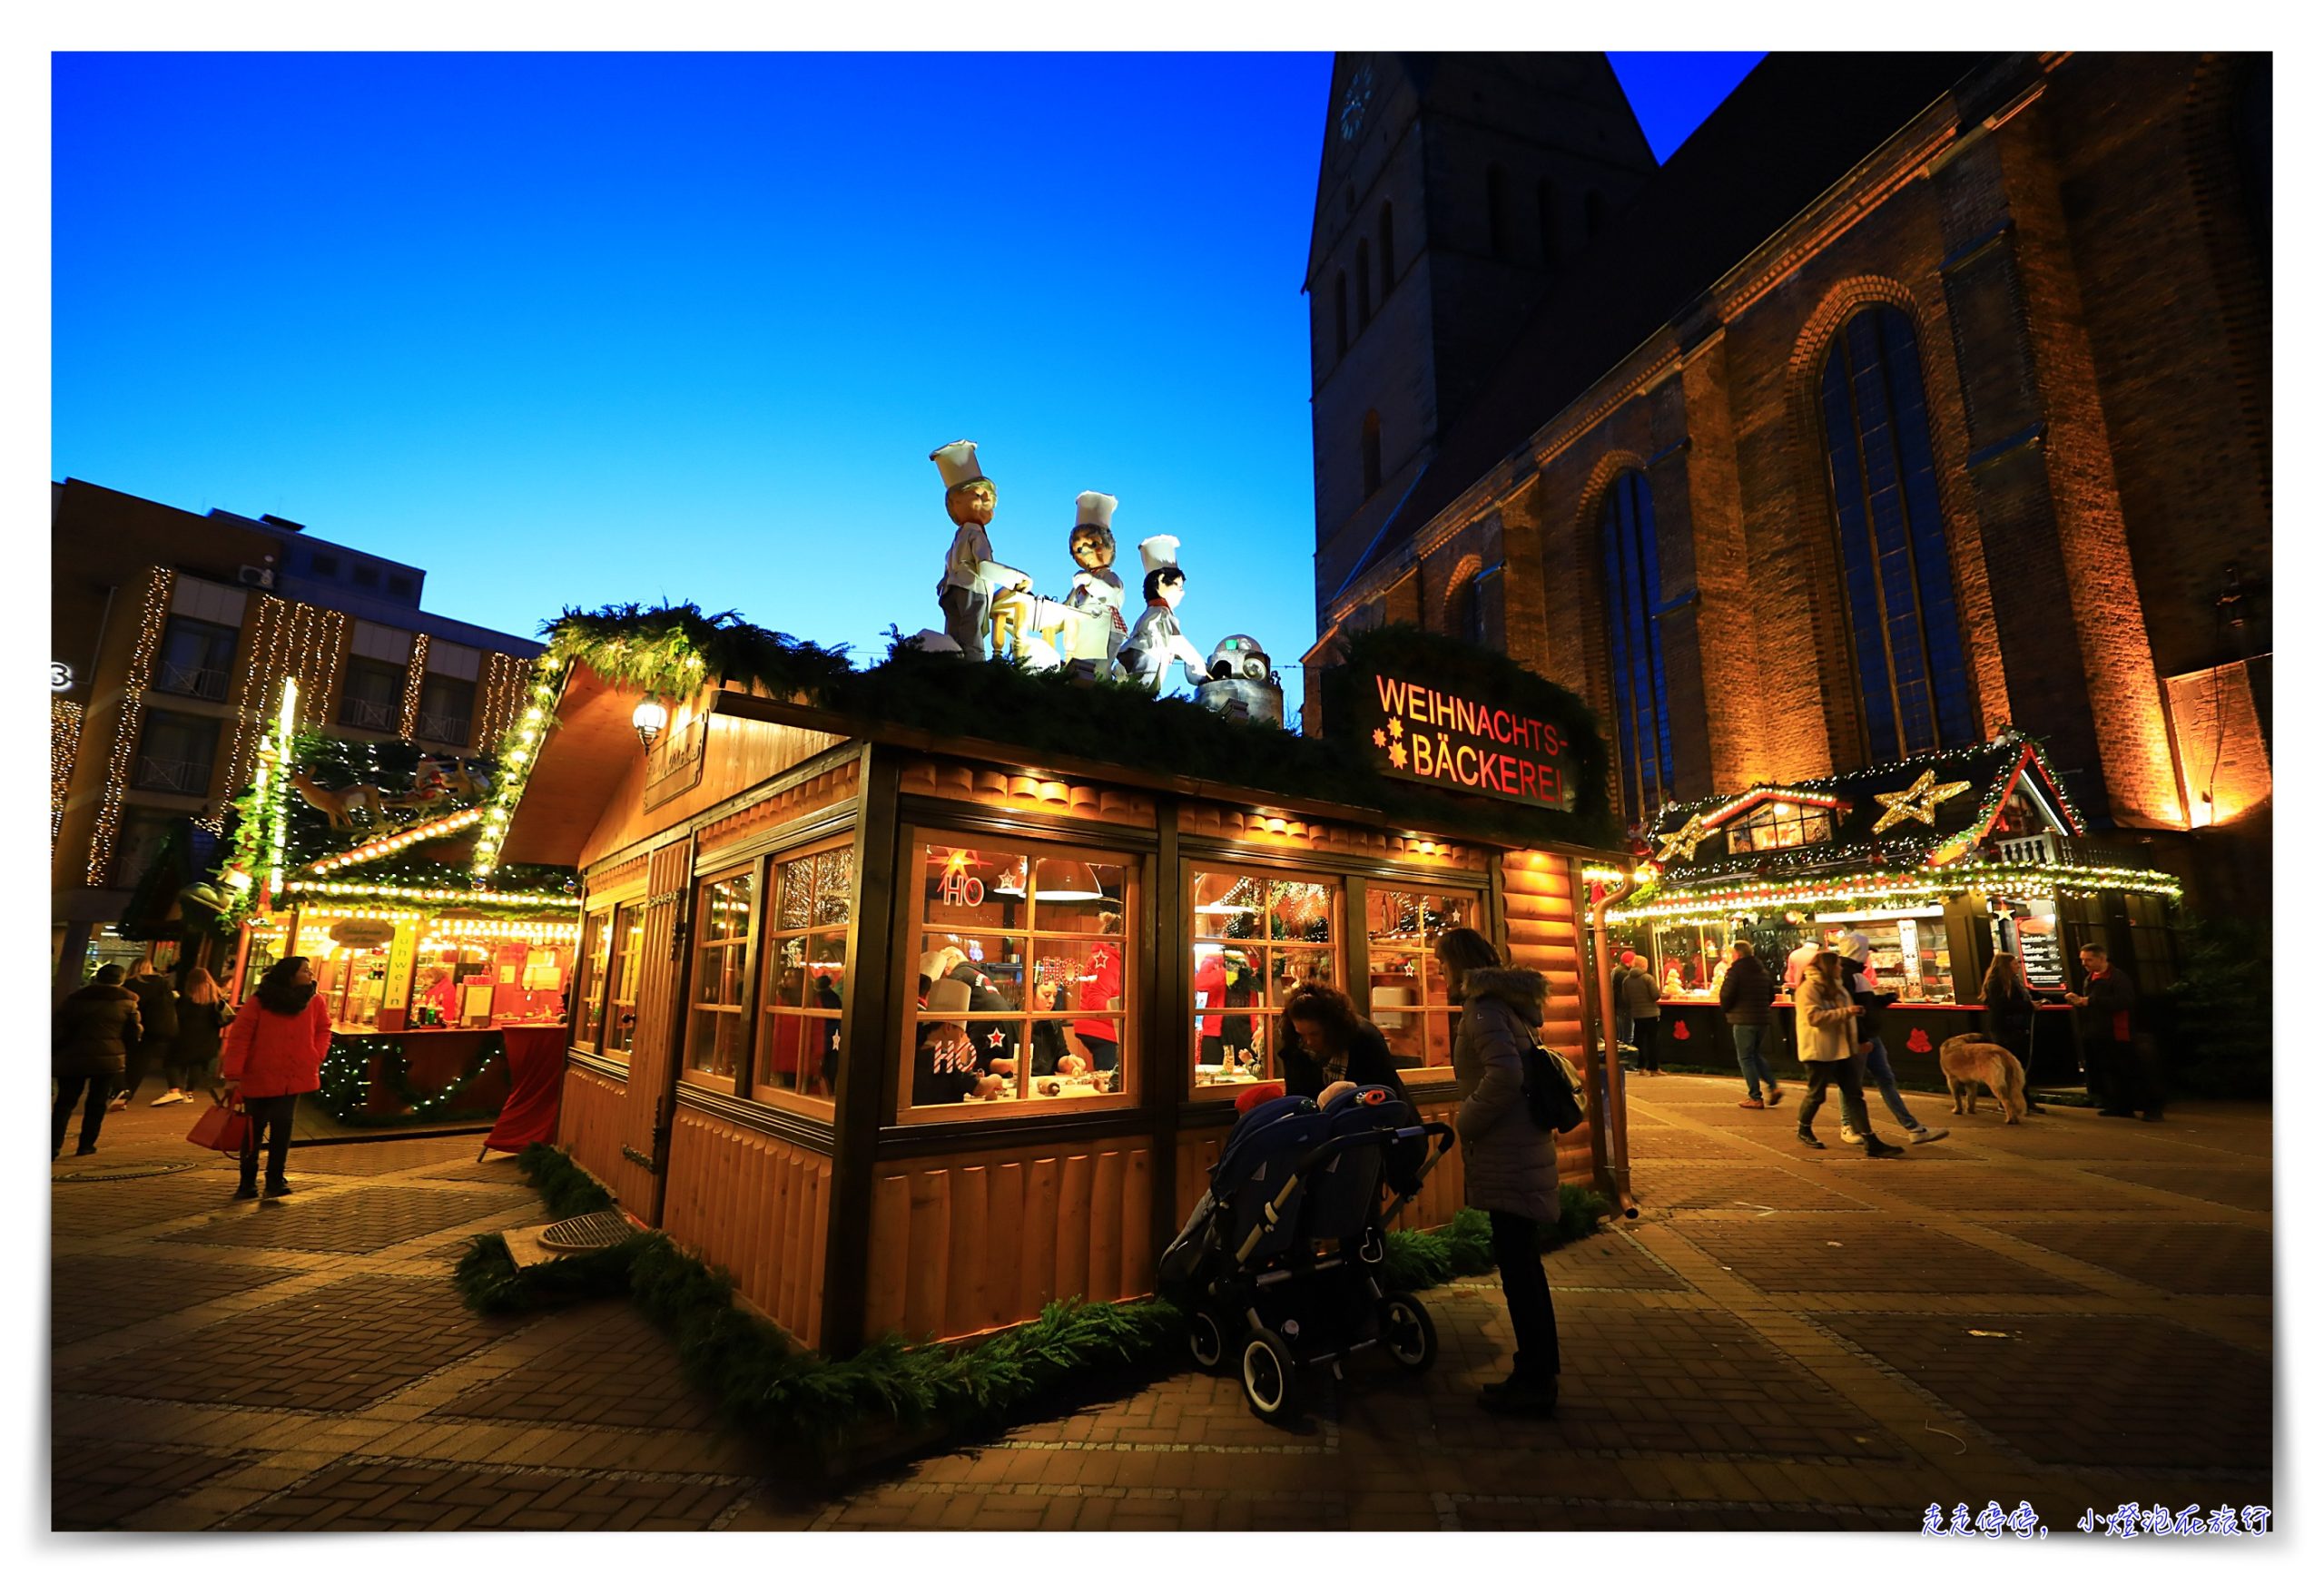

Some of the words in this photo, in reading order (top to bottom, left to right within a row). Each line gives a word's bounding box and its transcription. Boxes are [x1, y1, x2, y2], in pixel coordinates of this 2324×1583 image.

[1376, 674, 1569, 756] WEIHNACHTS-
[1412, 733, 1563, 804] BÄCKEREI
[943, 875, 984, 907] HO
[1042, 956, 1078, 987] HO
[933, 1040, 977, 1074] HO
